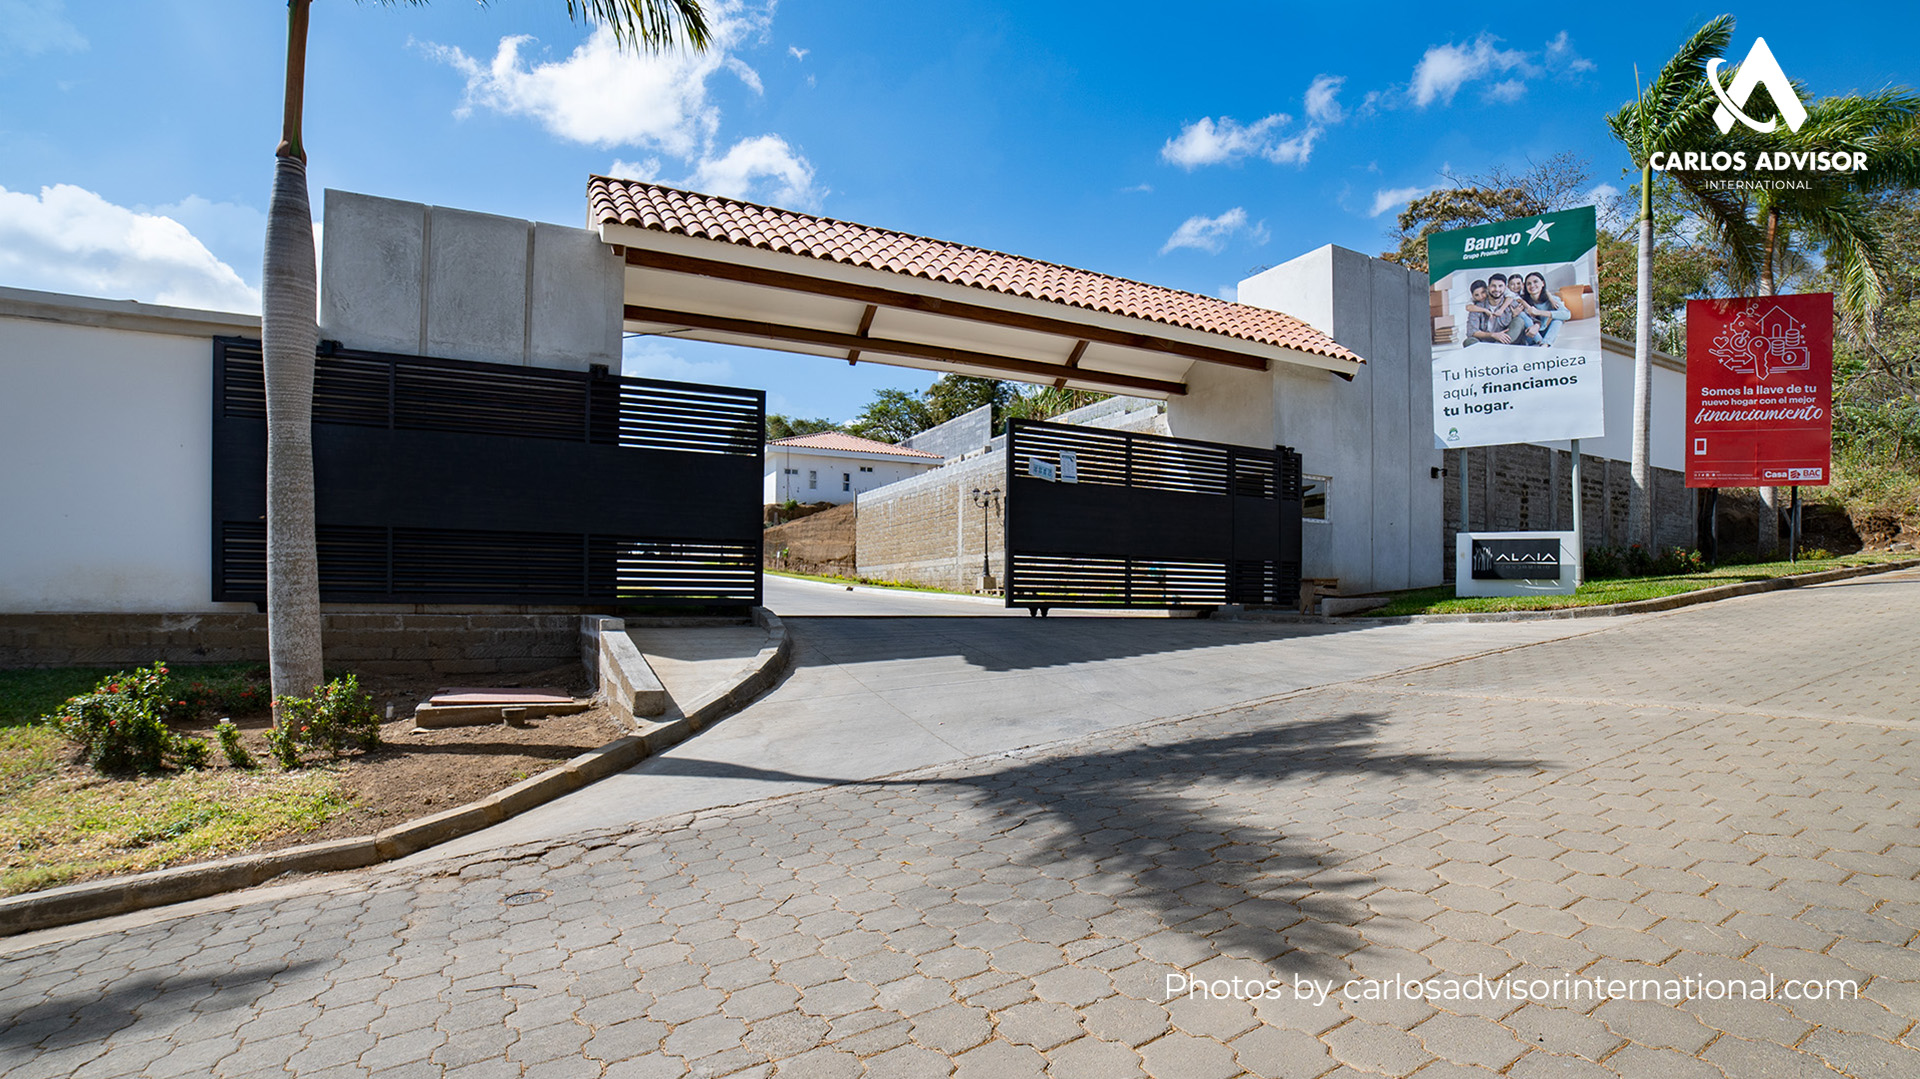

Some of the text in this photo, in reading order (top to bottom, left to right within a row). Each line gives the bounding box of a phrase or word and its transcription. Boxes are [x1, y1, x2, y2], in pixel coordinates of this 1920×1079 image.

[1464, 230, 1522, 253] Banpro
[1462, 248, 1509, 261] Grupo Promerica
[1441, 355, 1586, 382] Tu historia empieza
[1443, 375, 1578, 400] aquí, financiamos
[1701, 384, 1817, 397] Somos la llave de tu
[1443, 400, 1514, 417] tu hogar.
[1731, 398, 1758, 407] hogar
[1759, 397, 1777, 405] con
[1778, 396, 1787, 404] el
[1788, 396, 1817, 405] mejor
[1694, 404, 1823, 424] financiamiento
[1764, 469, 1821, 479] Casa BAC
[1496, 553, 1557, 562] ALAIA
